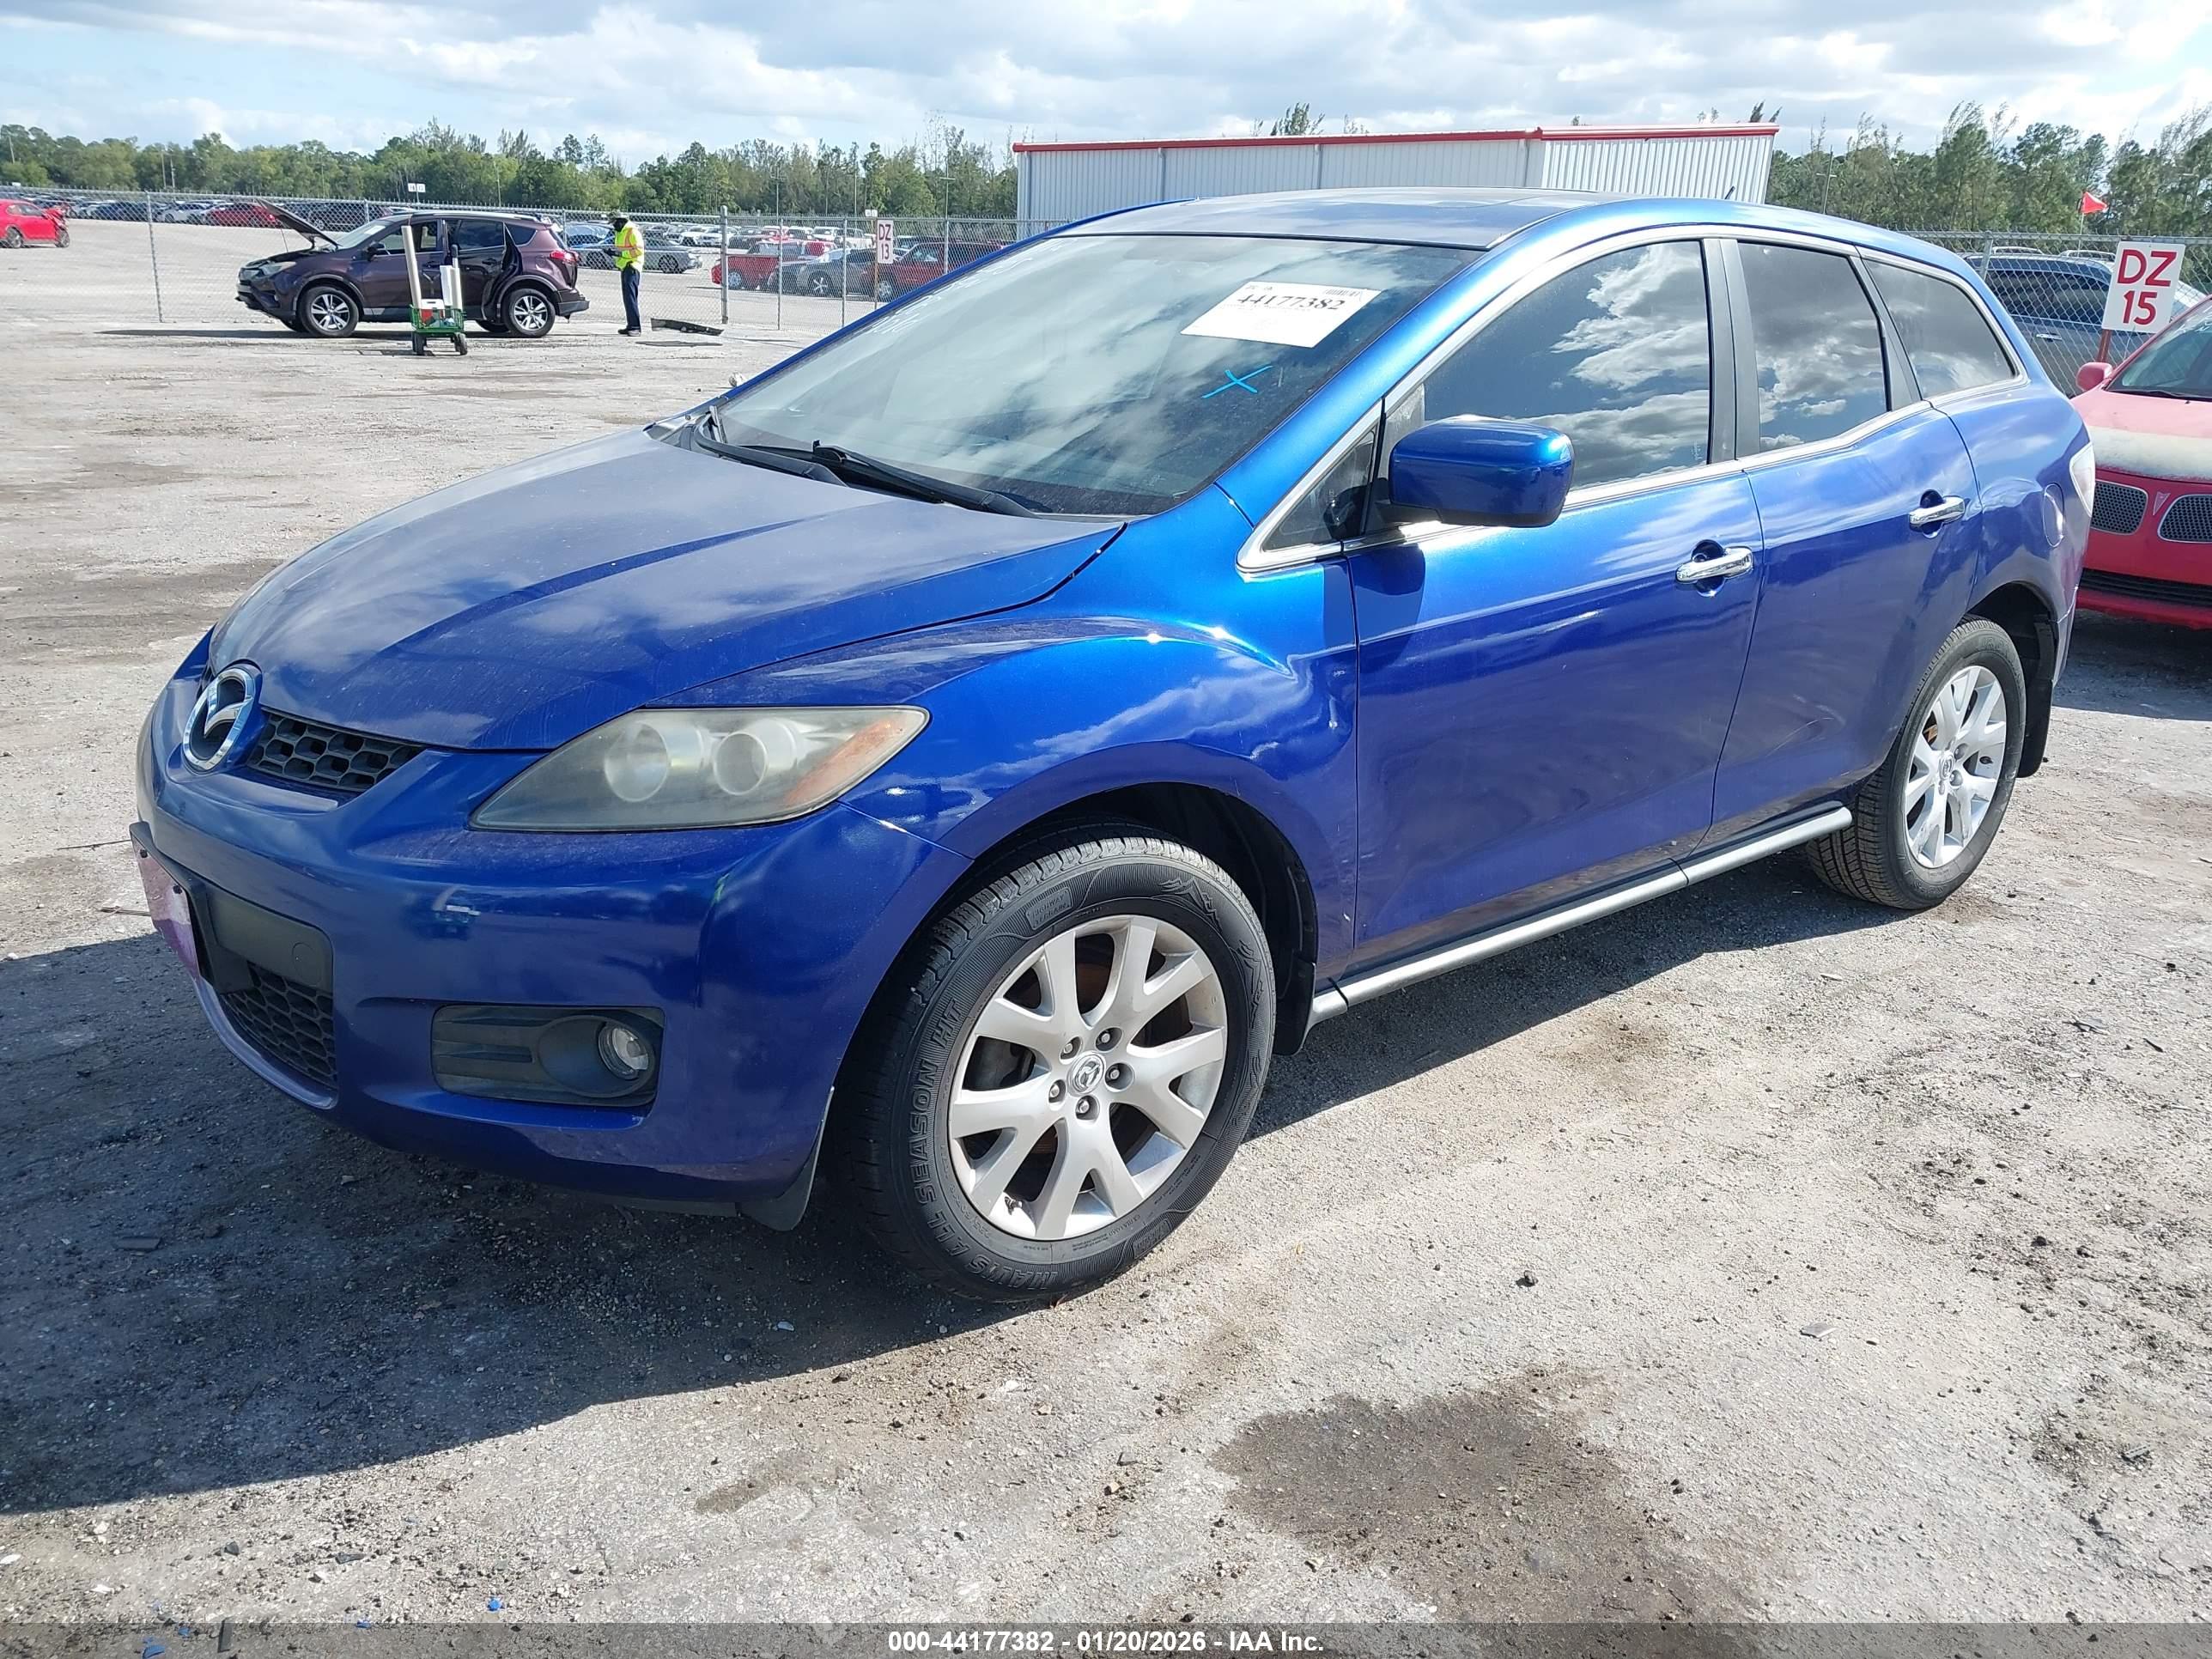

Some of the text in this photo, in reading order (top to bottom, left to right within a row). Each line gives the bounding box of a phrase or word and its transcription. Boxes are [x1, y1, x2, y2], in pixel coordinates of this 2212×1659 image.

[878, 224, 891, 240] DZ
[881, 244, 890, 260] 13
[2118, 249, 2177, 286] DZ
[1237, 294, 1346, 310] 44177382
[2123, 290, 2157, 325] 15
[930, 998, 963, 1049] HT
[908, 1058, 940, 1205] SEASON
[927, 1209, 971, 1256] ALL
